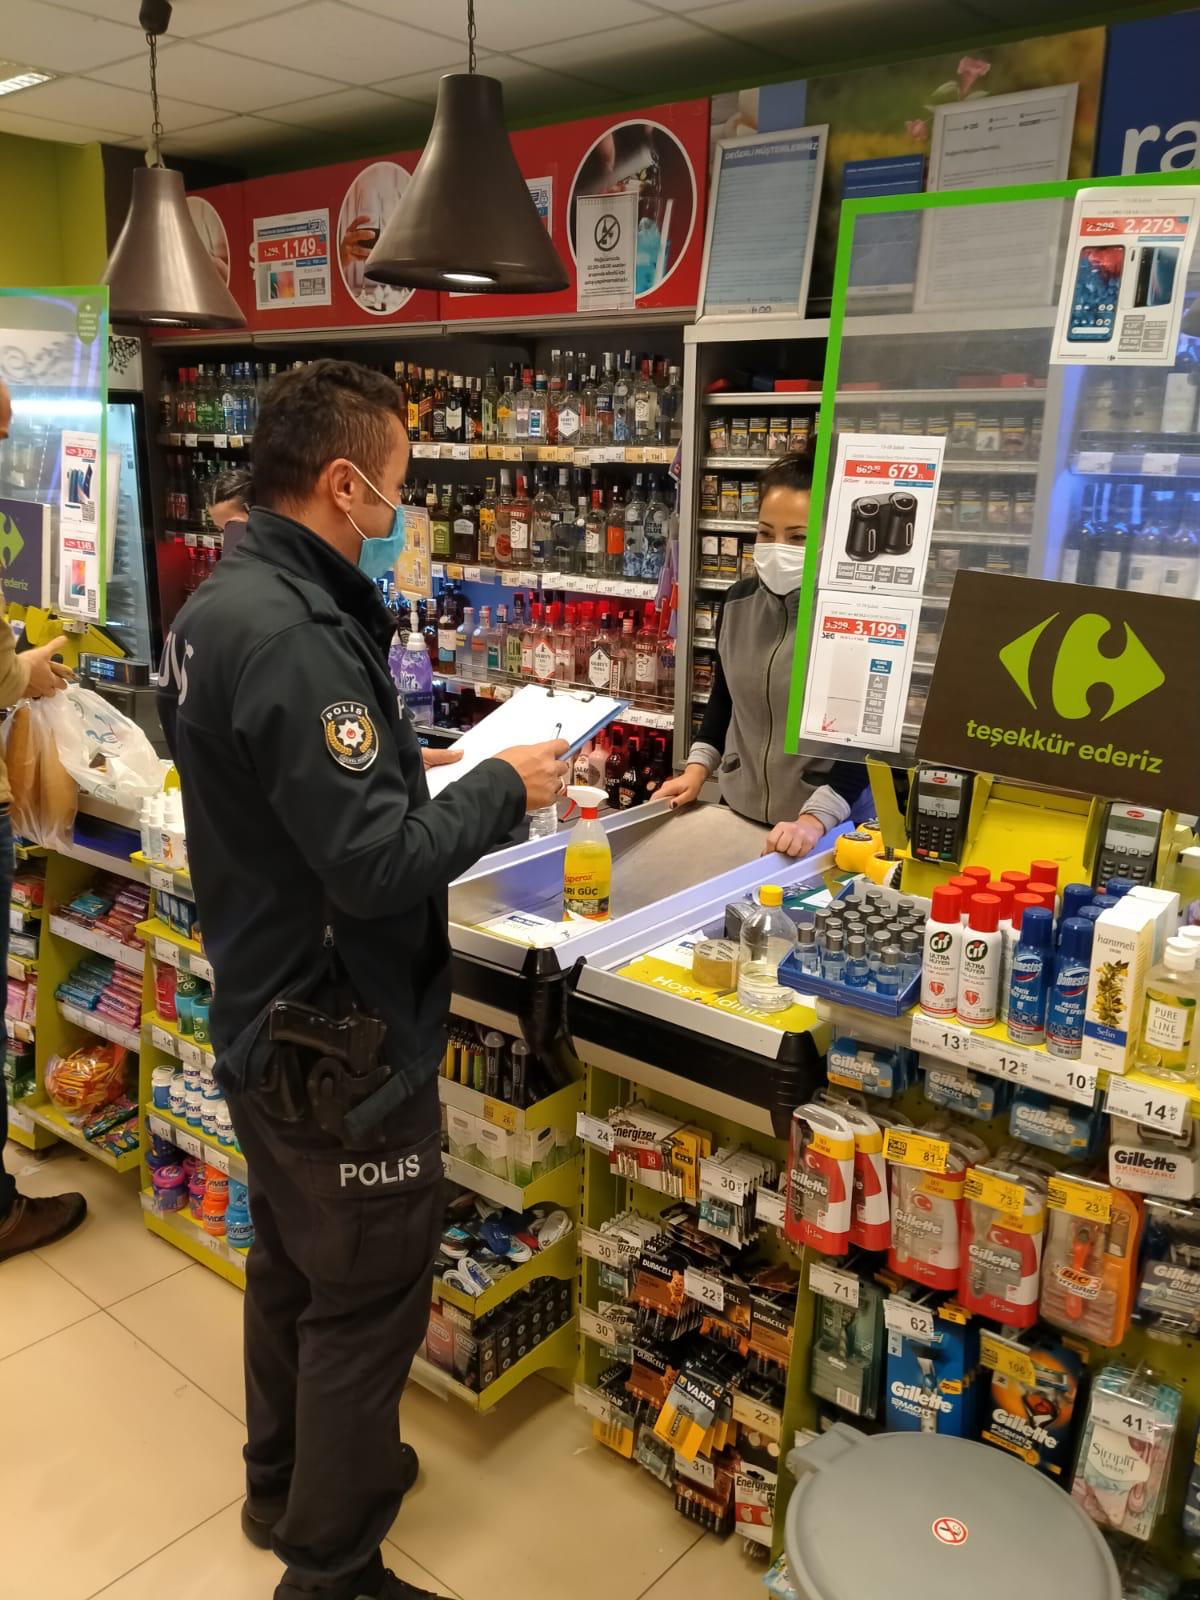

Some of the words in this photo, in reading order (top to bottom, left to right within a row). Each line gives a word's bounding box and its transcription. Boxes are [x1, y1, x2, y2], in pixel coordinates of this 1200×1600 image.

[1124, 218, 1174, 234] 2.279
[282, 238, 316, 259] 1.149
[888, 464, 918, 479] 679
[854, 620, 897, 638] 3.199
[326, 704, 362, 721] POLİS
[966, 719, 1076, 756] teşekkür
[1078, 743, 1164, 774] ederiz
[578, 886, 598, 896] GÜÇ
[930, 933, 950, 952] Cif
[966, 941, 986, 961] Cif
[1155, 1006, 1178, 1020] PURE
[1097, 1026, 1116, 1039] Selin
[1153, 1020, 1177, 1034] LINE
[941, 1033, 960, 1050] 13
[830, 1054, 880, 1076] Gillette
[1000, 1057, 1018, 1075] 12
[929, 1071, 982, 1098] Gillette
[1066, 1072, 1086, 1089] 10
[1144, 1101, 1167, 1120] 14
[1016, 1105, 1076, 1134] Gillette
[1013, 1129, 1021, 1137] 2
[923, 1151, 936, 1162] 81
[1114, 1150, 1177, 1173] Gillette
[339, 1154, 420, 1187] POLİS
[720, 1176, 736, 1192] 30
[790, 1169, 828, 1196] Gillette
[1115, 1176, 1122, 1187] 2
[1085, 1201, 1100, 1213] 23
[895, 1208, 942, 1234] Gillette
[968, 1244, 1021, 1271] Gillette
[642, 1258, 673, 1277] DURACELL
[702, 1286, 716, 1301] 22
[833, 1282, 850, 1298] 71
[753, 1311, 786, 1331] DURACELL
[911, 1317, 928, 1333] 62
[596, 1323, 608, 1337] 30
[636, 1351, 665, 1370] DURACELL
[685, 1381, 716, 1411] VARTA
[891, 1381, 953, 1413] Gillette
[755, 1409, 770, 1425] 22
[1122, 1414, 1143, 1431] 41
[991, 1408, 1057, 1449] Gillette
[692, 1461, 706, 1475] 31
